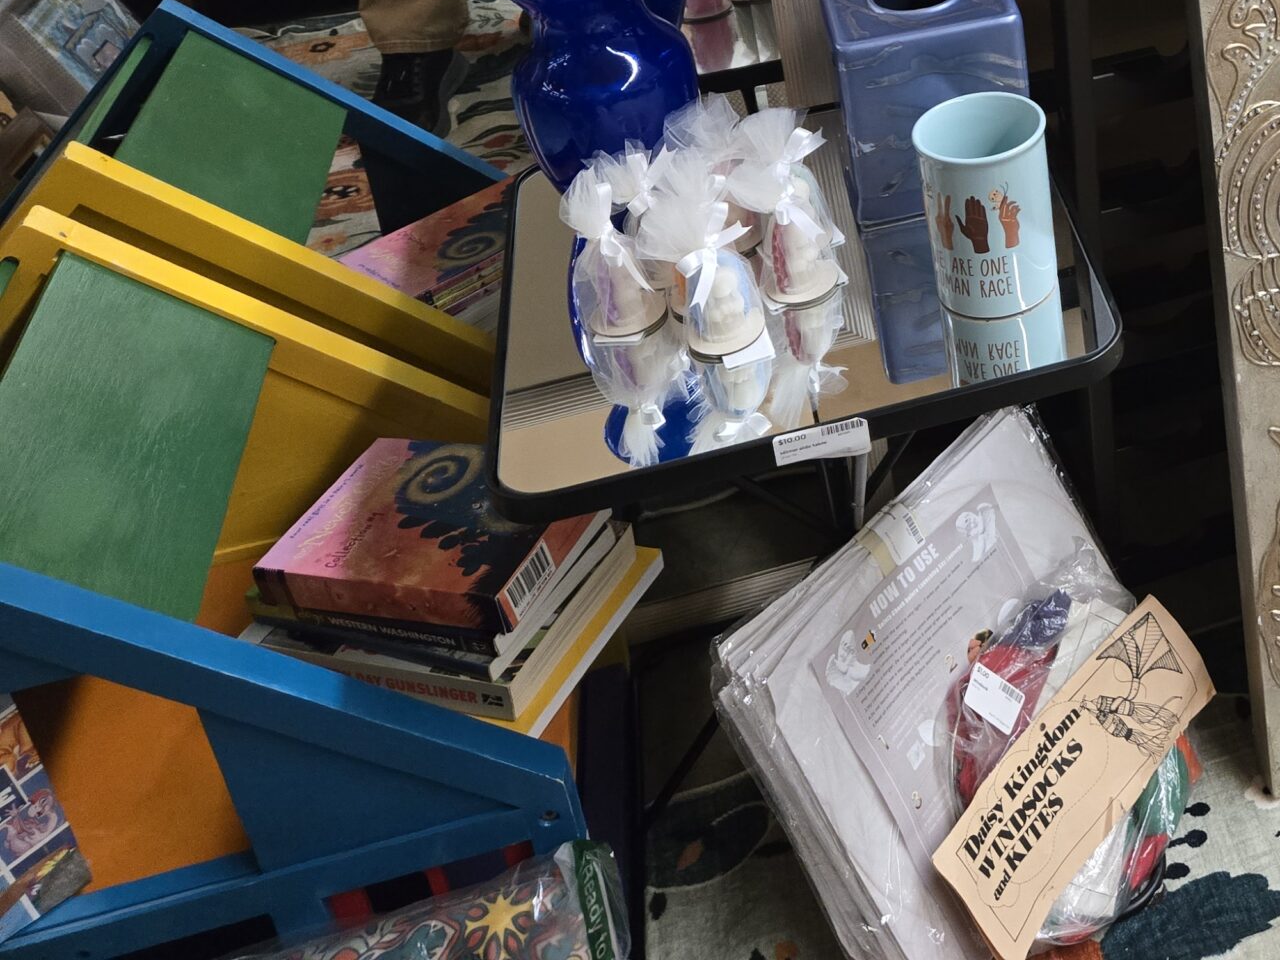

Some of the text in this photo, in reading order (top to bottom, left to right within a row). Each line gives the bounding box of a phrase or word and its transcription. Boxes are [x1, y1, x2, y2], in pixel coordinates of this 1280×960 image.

[951, 257, 974, 277] ARE
[980, 255, 1010, 277] ONE
[939, 270, 1013, 298] UMAN RACE
[778, 433, 807, 446] $10.00
[324, 524, 373, 569] Collection
[869, 581, 900, 618] HOW
[897, 566, 916, 589] TO
[913, 543, 940, 572] USE
[327, 615, 457, 647] WESTERN WASHINGTON
[944, 654, 958, 674] 2
[385, 677, 478, 704] GUNSLINGER
[911, 790, 922, 810] 3
[963, 708, 1081, 862] Daisy Kingdom
[978, 738, 1083, 879] WINDSOCKS
[994, 792, 1064, 901] and KITES
[583, 863, 608, 960] Ready to
